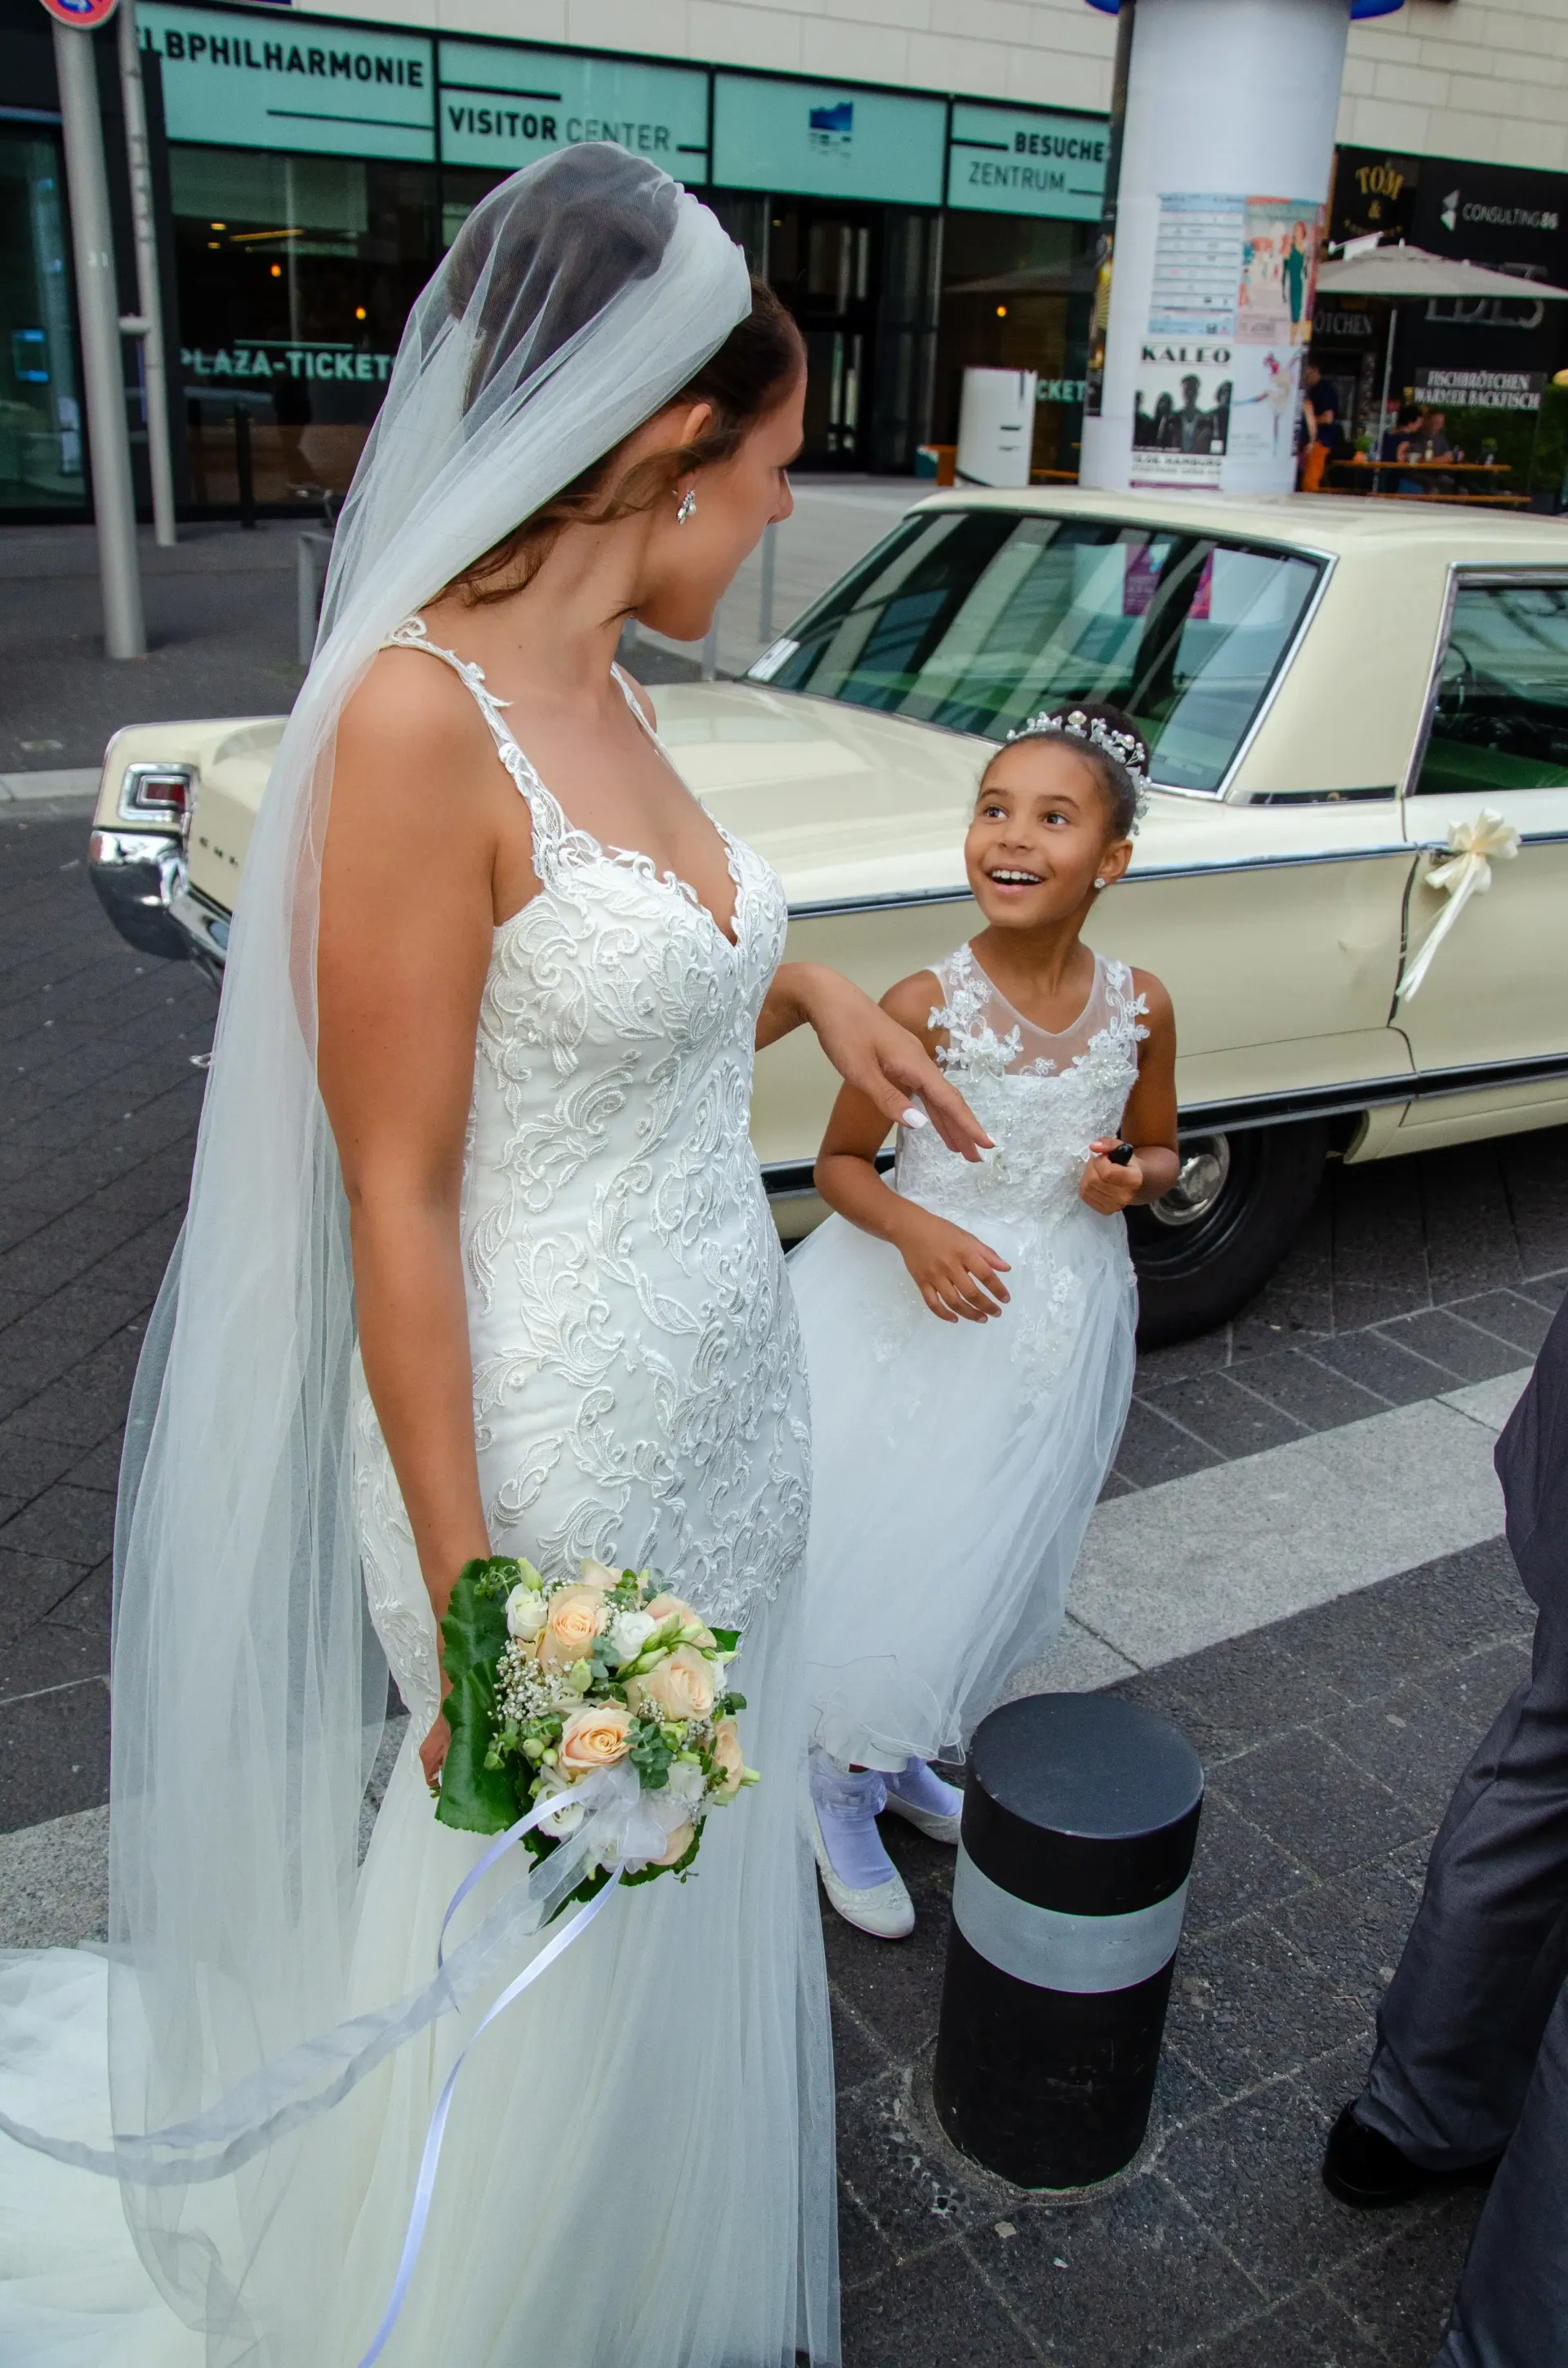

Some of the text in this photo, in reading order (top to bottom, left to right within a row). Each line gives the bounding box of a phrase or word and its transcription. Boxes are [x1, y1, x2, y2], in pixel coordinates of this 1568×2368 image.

[136, 26, 424, 87] LBPHILHARMONIE
[448, 105, 670, 151] VISITOR CENTER
[1014, 131, 1106, 163] BESUCHE
[969, 161, 1067, 192] ZENTRUM
[1356, 165, 1404, 200] TOM
[180, 347, 395, 381] PLAZA-TICKET
[1142, 345, 1231, 363] KALEO
